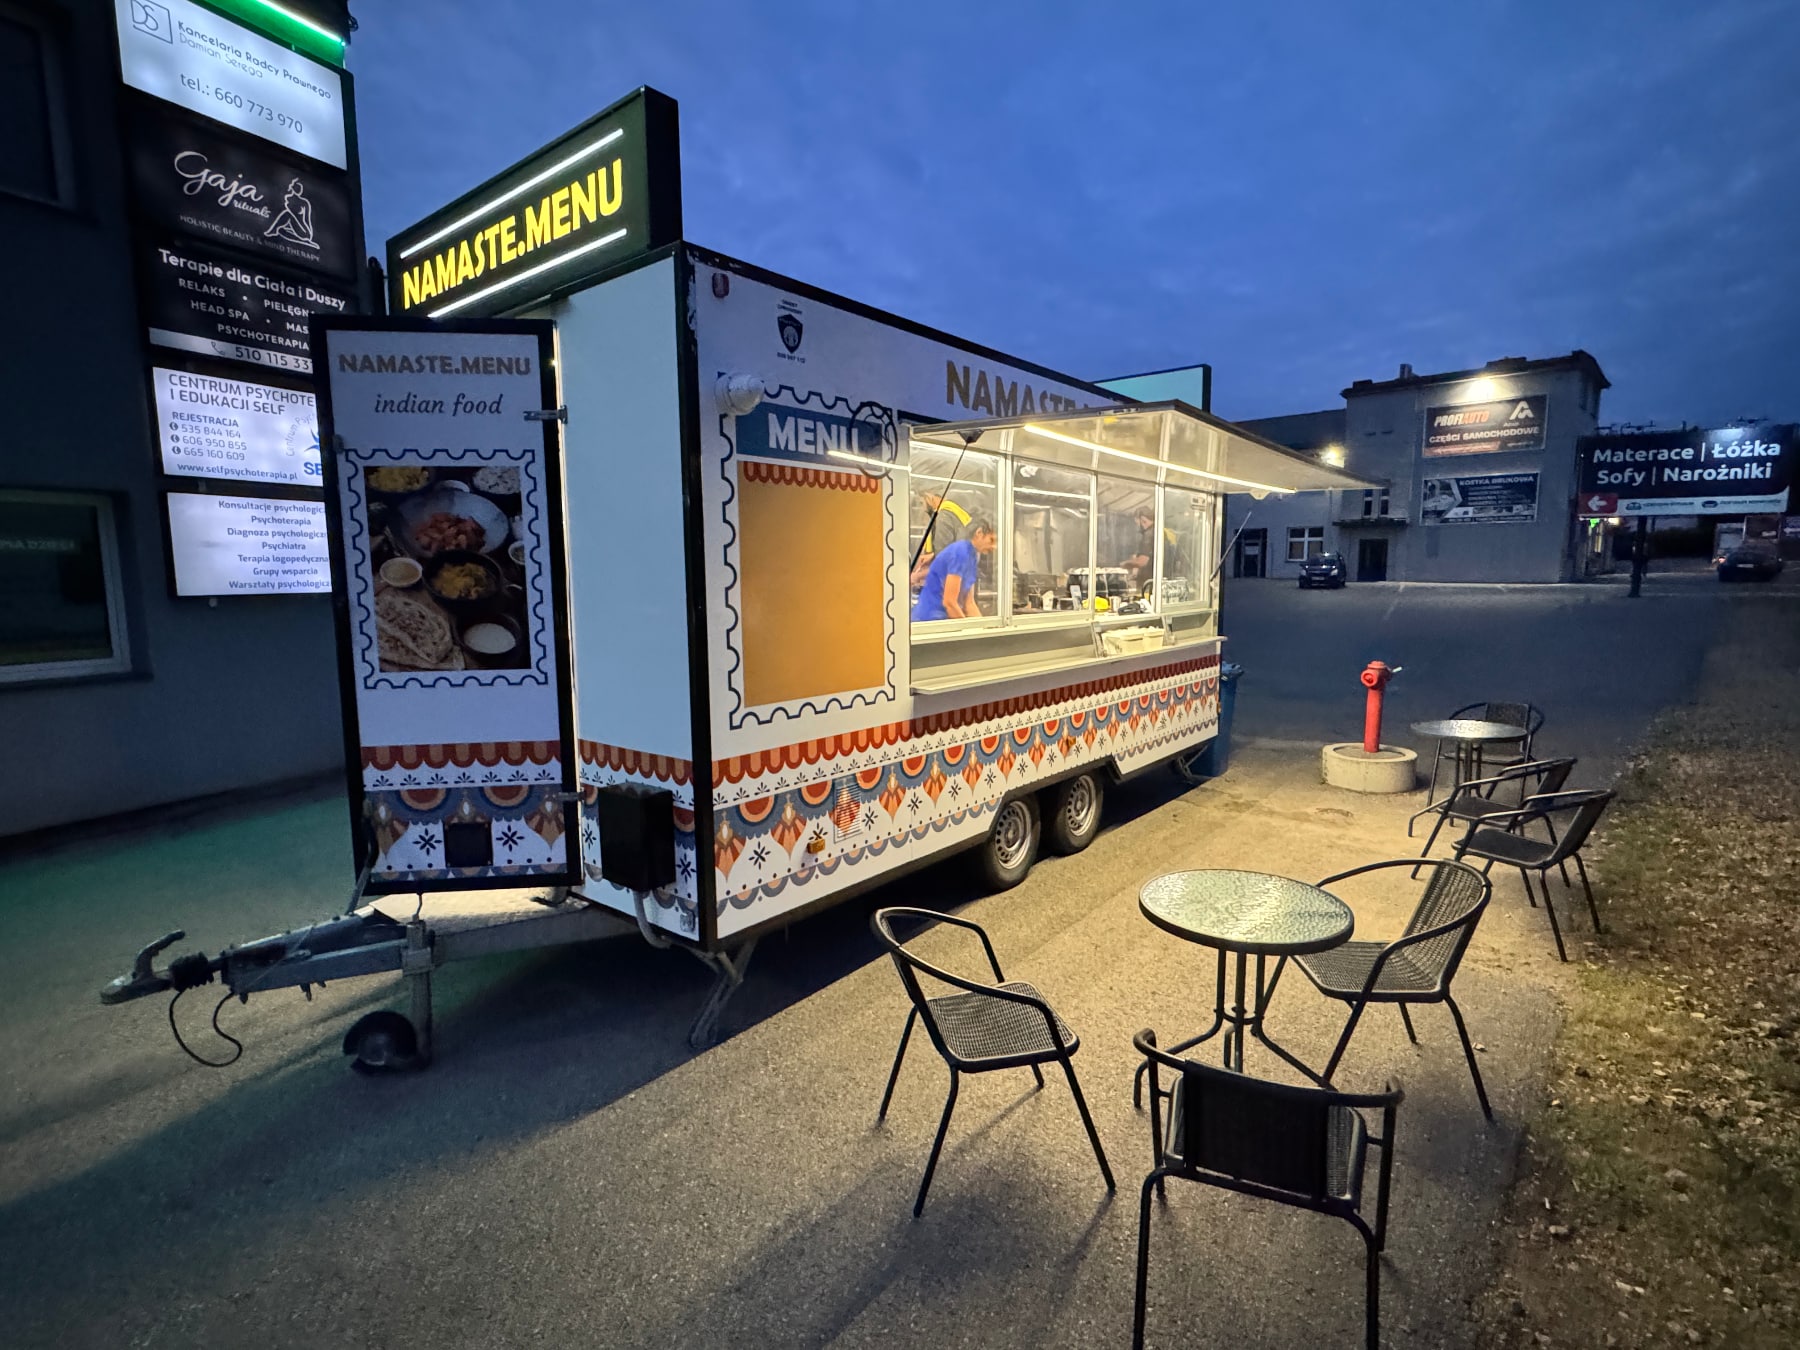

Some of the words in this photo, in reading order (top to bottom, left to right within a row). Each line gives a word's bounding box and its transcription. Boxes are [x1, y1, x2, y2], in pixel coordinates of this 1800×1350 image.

[179, 32, 221, 59] Damian
[178, 20, 242, 58] Kancelaria
[245, 51, 280, 76] Radcy
[283, 67, 332, 99] Prawnego
[180, 72, 210, 96] tel.:
[214, 87, 243, 109] 660
[246, 99, 274, 122] 773
[277, 113, 303, 134] 970
[174, 150, 264, 208] Gaja
[233, 198, 272, 218] rituals
[180, 214, 221, 233] HOLISTIC
[222, 227, 255, 243] BEAUTY
[286, 246, 321, 262] THERAPY
[402, 158, 623, 311] NAMASTE.MENU
[158, 248, 223, 279] Terapie
[226, 267, 251, 285] dla
[254, 275, 295, 297] Ciała
[297, 287, 303, 299] i
[305, 288, 346, 311] Duszy
[178, 278, 226, 298] RELAKS
[263, 299, 315, 318] PIELĘGN
[191, 300, 225, 316] HEAD
[228, 308, 250, 322] SPA
[217, 323, 310, 351] PSYCHOTERAPIA
[235, 346, 262, 361] 510
[265, 351, 288, 366] 115
[293, 357, 313, 371] 33
[337, 353, 532, 376] NAMASTE.MENU
[168, 374, 242, 395] CENTRUM
[246, 385, 315, 408] PSYCHOTE
[169, 388, 175, 400] I
[179, 389, 250, 411] EDUKACJI
[253, 402, 286, 416] SELF
[374, 391, 445, 414] indian
[452, 392, 504, 417] food
[172, 411, 239, 428] REJESTRACJA
[1434, 410, 1489, 427] PROFIAUTO
[181, 423, 201, 435] 535
[203, 426, 223, 437] 844
[225, 428, 241, 439] 164
[767, 412, 859, 455] MENU
[1429, 433, 1460, 443] CZĘŚCI
[1463, 426, 1539, 440] SAMOCHODOWE
[182, 435, 203, 447] 606
[205, 438, 226, 449] 950
[228, 439, 247, 451] 855
[183, 447, 204, 458] 665
[206, 449, 223, 460] 160
[226, 450, 245, 461] 609
[1593, 447, 1694, 464] Materace
[1711, 440, 1781, 459] Łóżka
[1596, 467, 1646, 486] Sofy
[1663, 462, 1773, 482] Narożniki
[218, 500, 272, 513] Konsultacje
[274, 501, 326, 516] psychologic
[251, 515, 312, 528] Psychoterapia
[227, 528, 269, 539] Diagnoza
[272, 529, 327, 540] psychologicz
[262, 541, 306, 552] Psychiatra
[237, 554, 270, 564] Terapia
[272, 553, 329, 565] logopedyczna
[253, 567, 279, 578] Grupy
[281, 567, 318, 577] wsparcia
[229, 580, 275, 590] Warsztaty
[277, 579, 331, 590] psychologicz
